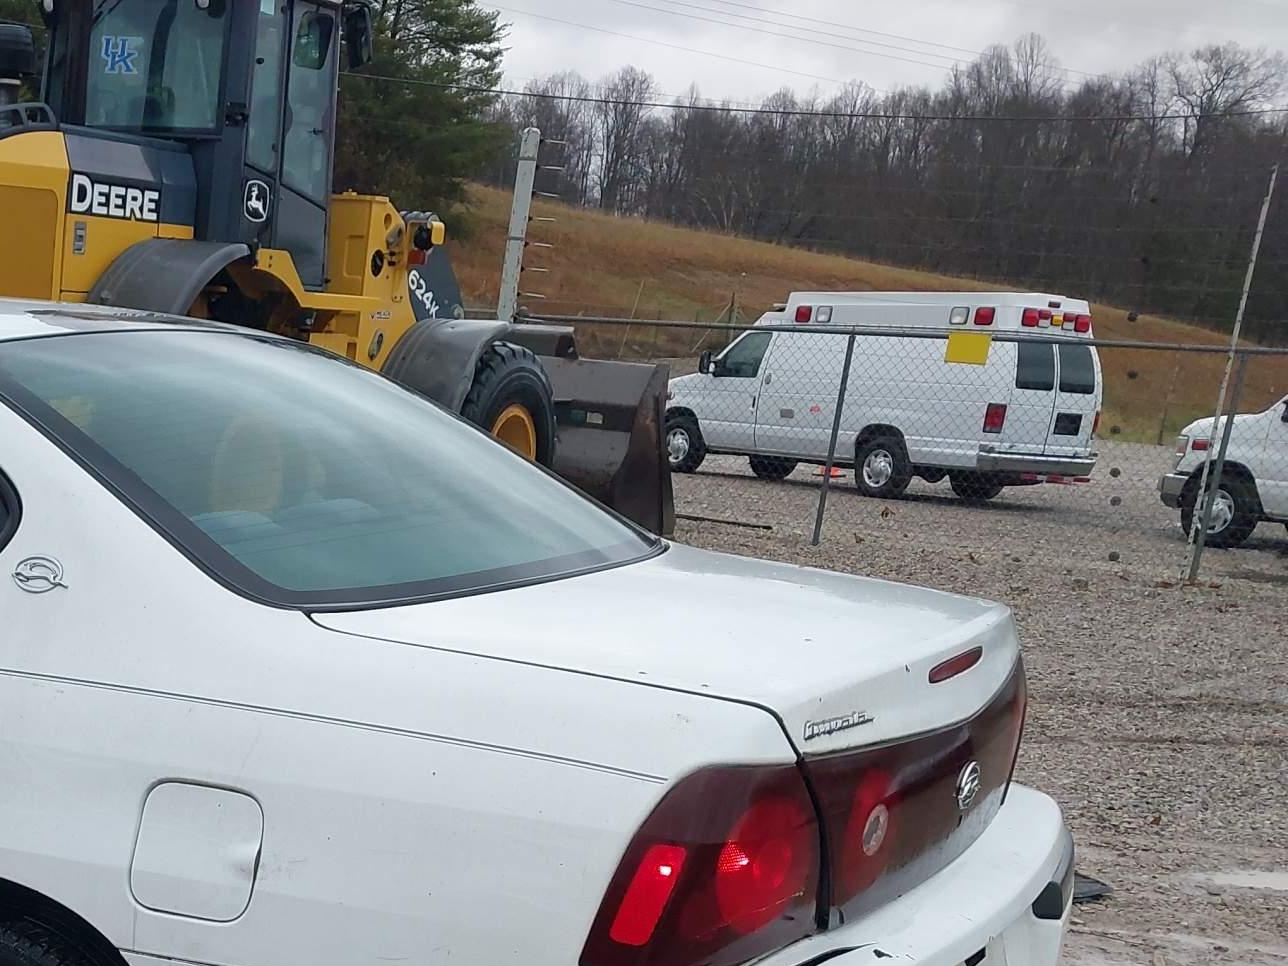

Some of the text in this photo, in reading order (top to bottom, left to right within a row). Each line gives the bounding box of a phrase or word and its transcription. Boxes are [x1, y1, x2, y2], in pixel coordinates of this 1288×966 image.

[102, 35, 137, 74] UK
[71, 173, 160, 221] DEERE
[408, 269, 440, 320] 624K
[804, 711, 877, 741] Impala
